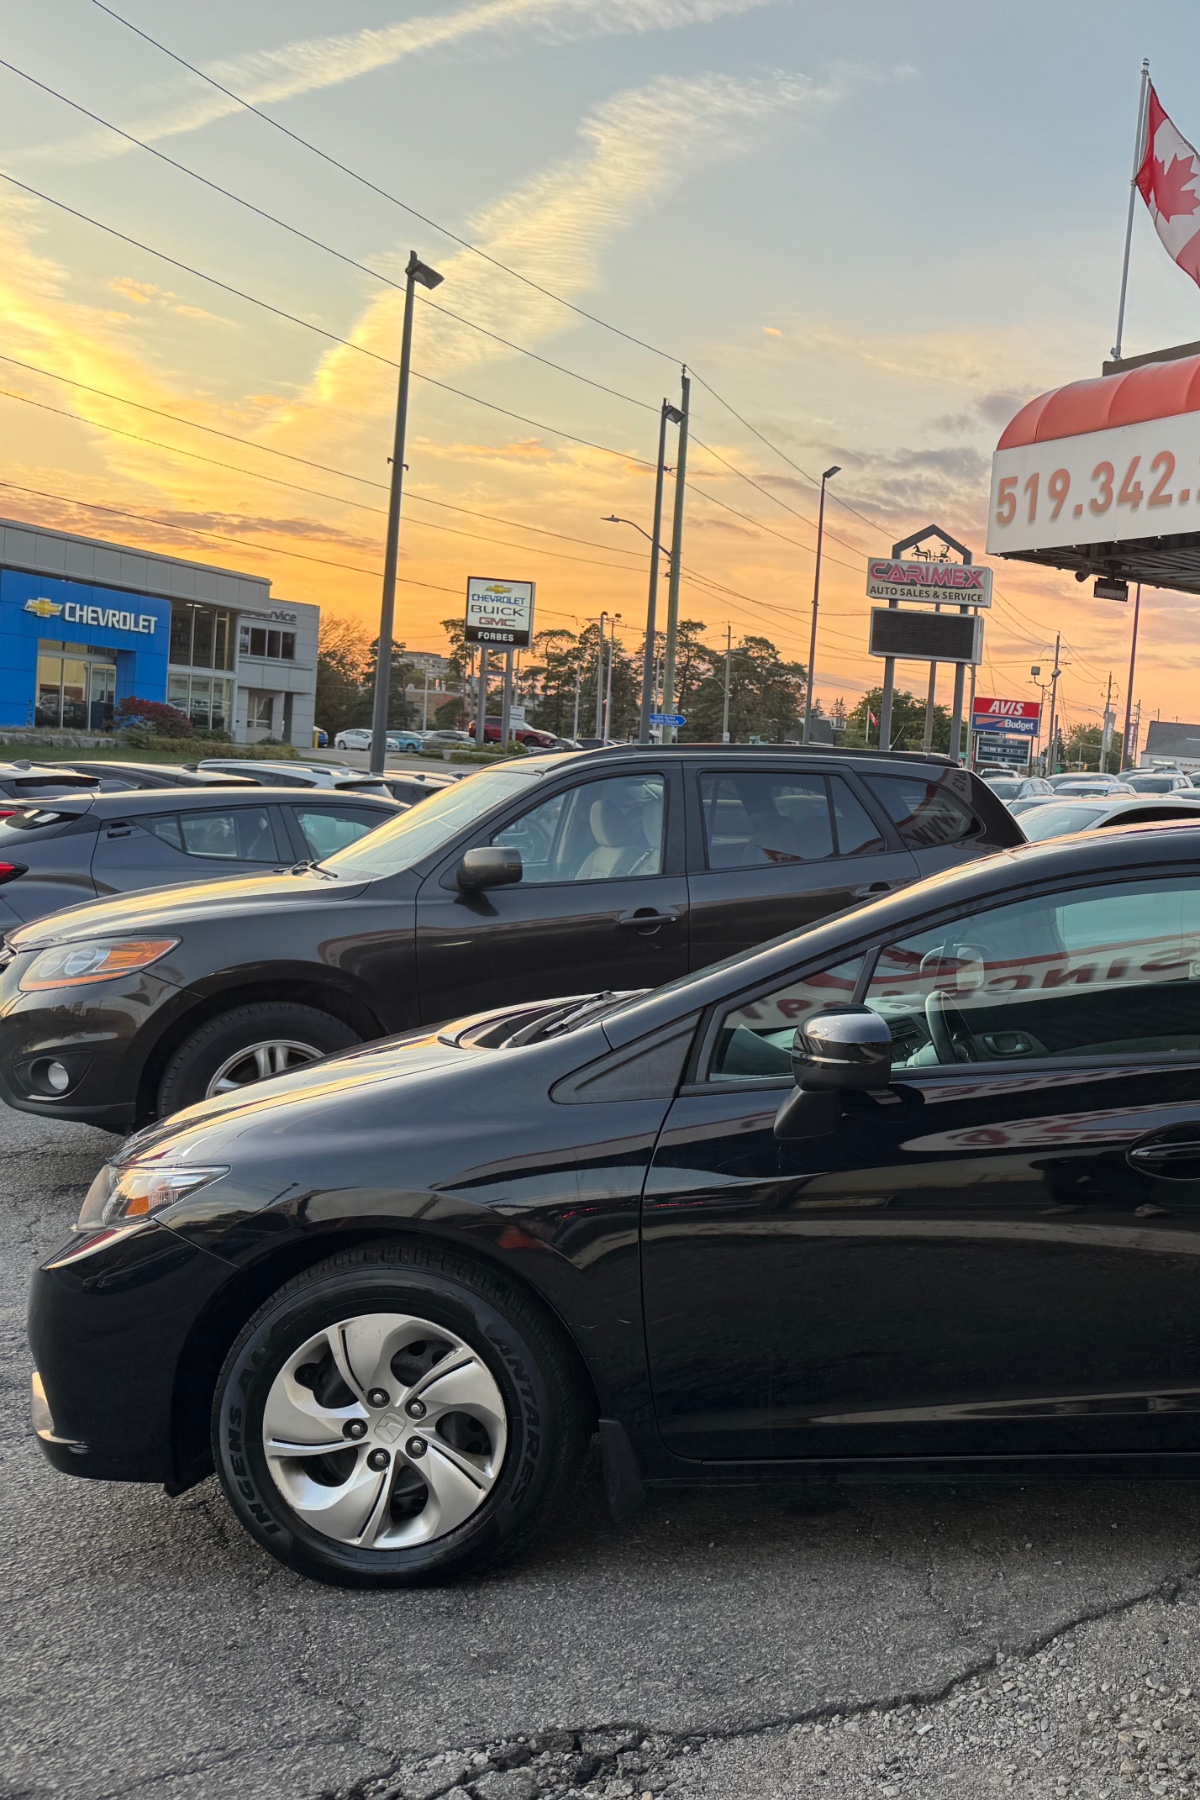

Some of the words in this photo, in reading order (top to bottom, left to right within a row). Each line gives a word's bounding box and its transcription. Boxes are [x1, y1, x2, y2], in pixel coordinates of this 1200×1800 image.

[869, 561, 986, 589] CARIMEX
[471, 593, 526, 606] CHEVROLET
[869, 585, 898, 596] AUTO
[899, 588, 930, 599] SALES
[932, 590, 941, 599] &
[942, 592, 983, 603] SERVICE
[63, 602, 158, 635] CHEVROLET
[470, 604, 525, 618] BUICK
[478, 616, 516, 628] GMC
[477, 631, 515, 642] FORBES
[988, 700, 1025, 716] AVIS
[1004, 719, 1035, 732] Budget
[488, 1334, 542, 1510] ANTARES
[228, 1404, 282, 1535] INGENS
